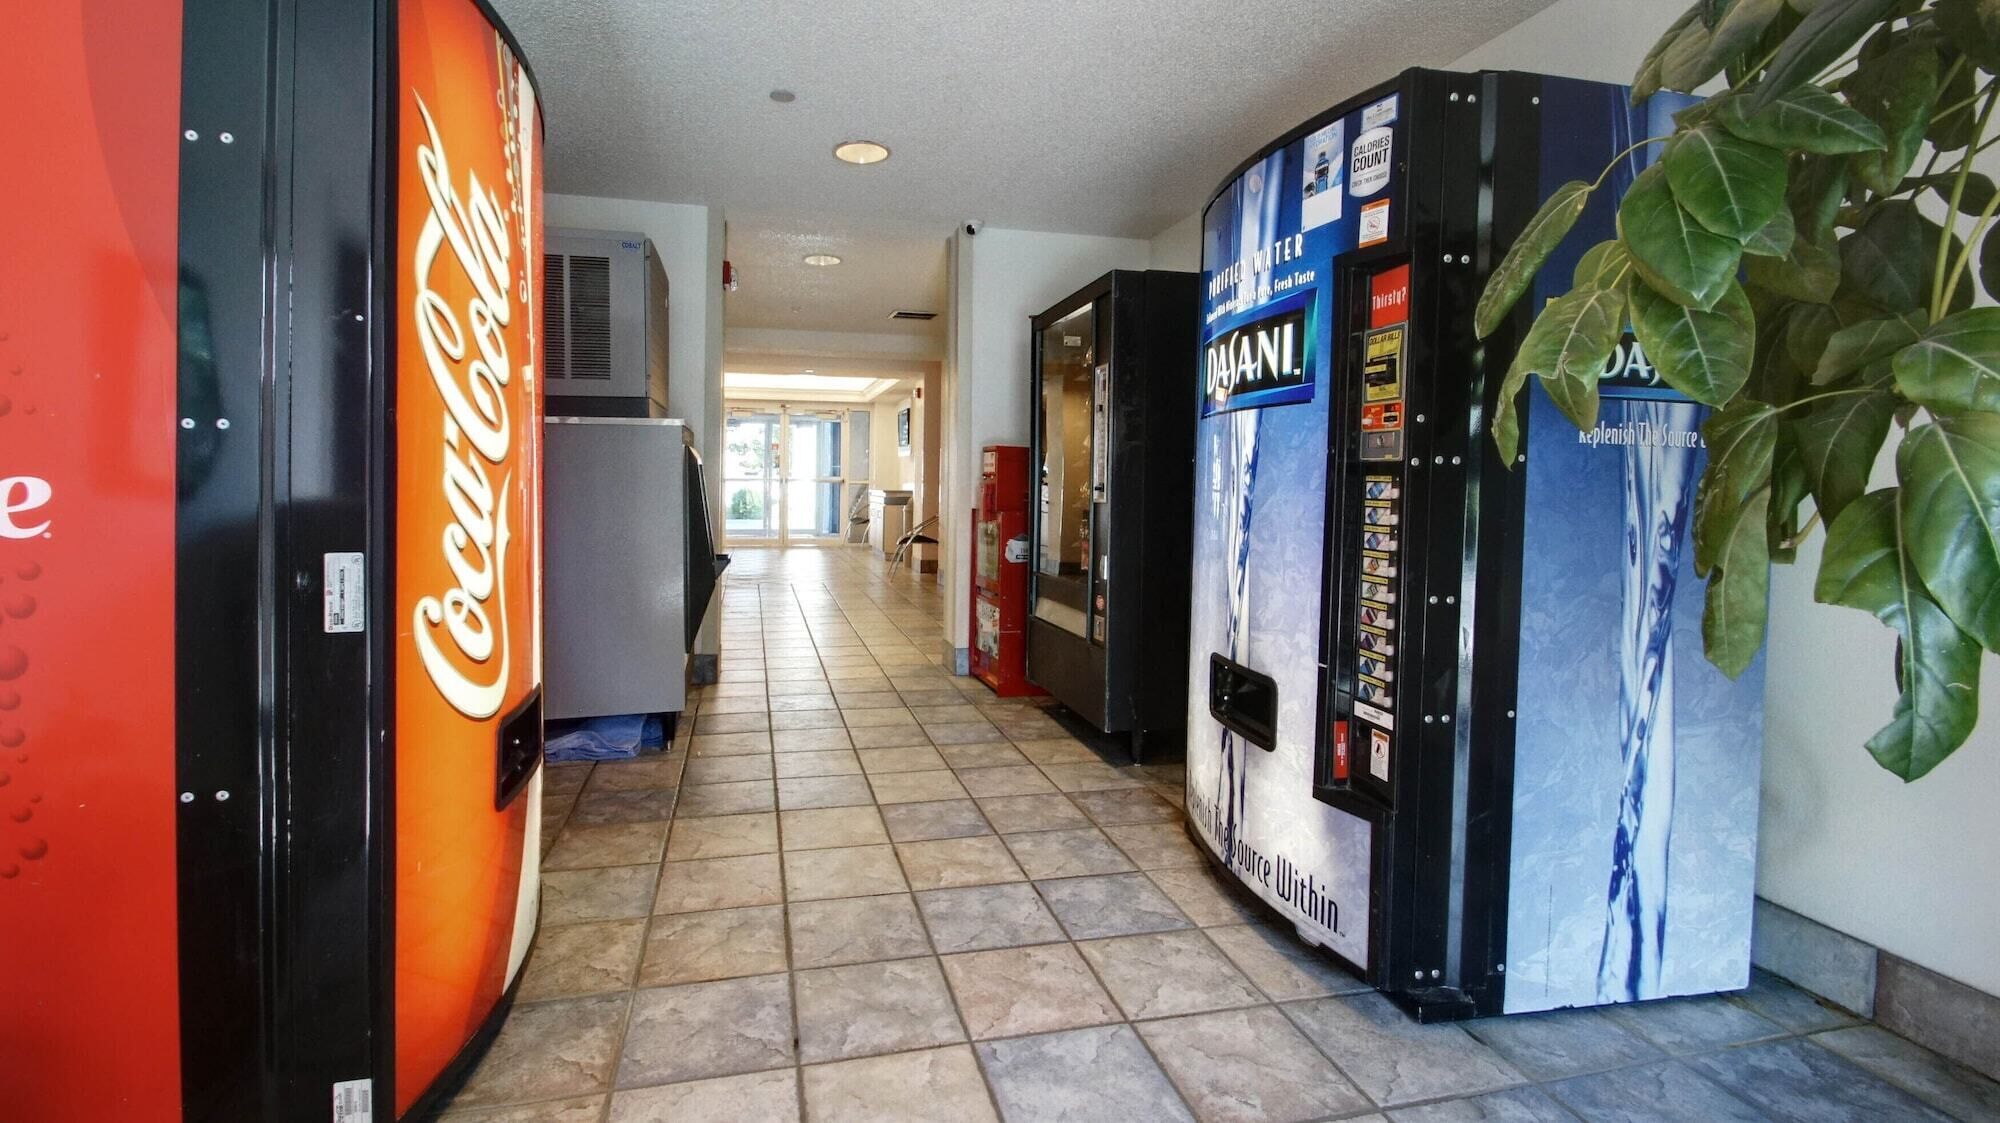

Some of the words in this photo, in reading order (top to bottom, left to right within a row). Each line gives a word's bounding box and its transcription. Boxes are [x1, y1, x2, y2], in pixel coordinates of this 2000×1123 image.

[1352, 147, 1389, 173] COUNT
[1353, 135, 1390, 157] CALORIES
[1208, 259, 1246, 301] PURIFIED
[1252, 233, 1304, 275] WATER
[1274, 275, 1293, 293] Fresh
[1294, 270, 1316, 285] Taste
[1371, 286, 1407, 311] Thirsty?
[1206, 322, 1295, 397] DASANI
[1599, 341, 1661, 386] DA
[413, 86, 513, 719] Coca-Cola
[1638, 422, 1657, 445] The
[1661, 423, 1698, 449] Source
[1214, 803, 1229, 851] The
[1231, 823, 1271, 889] Source
[1276, 854, 1338, 934] Within
